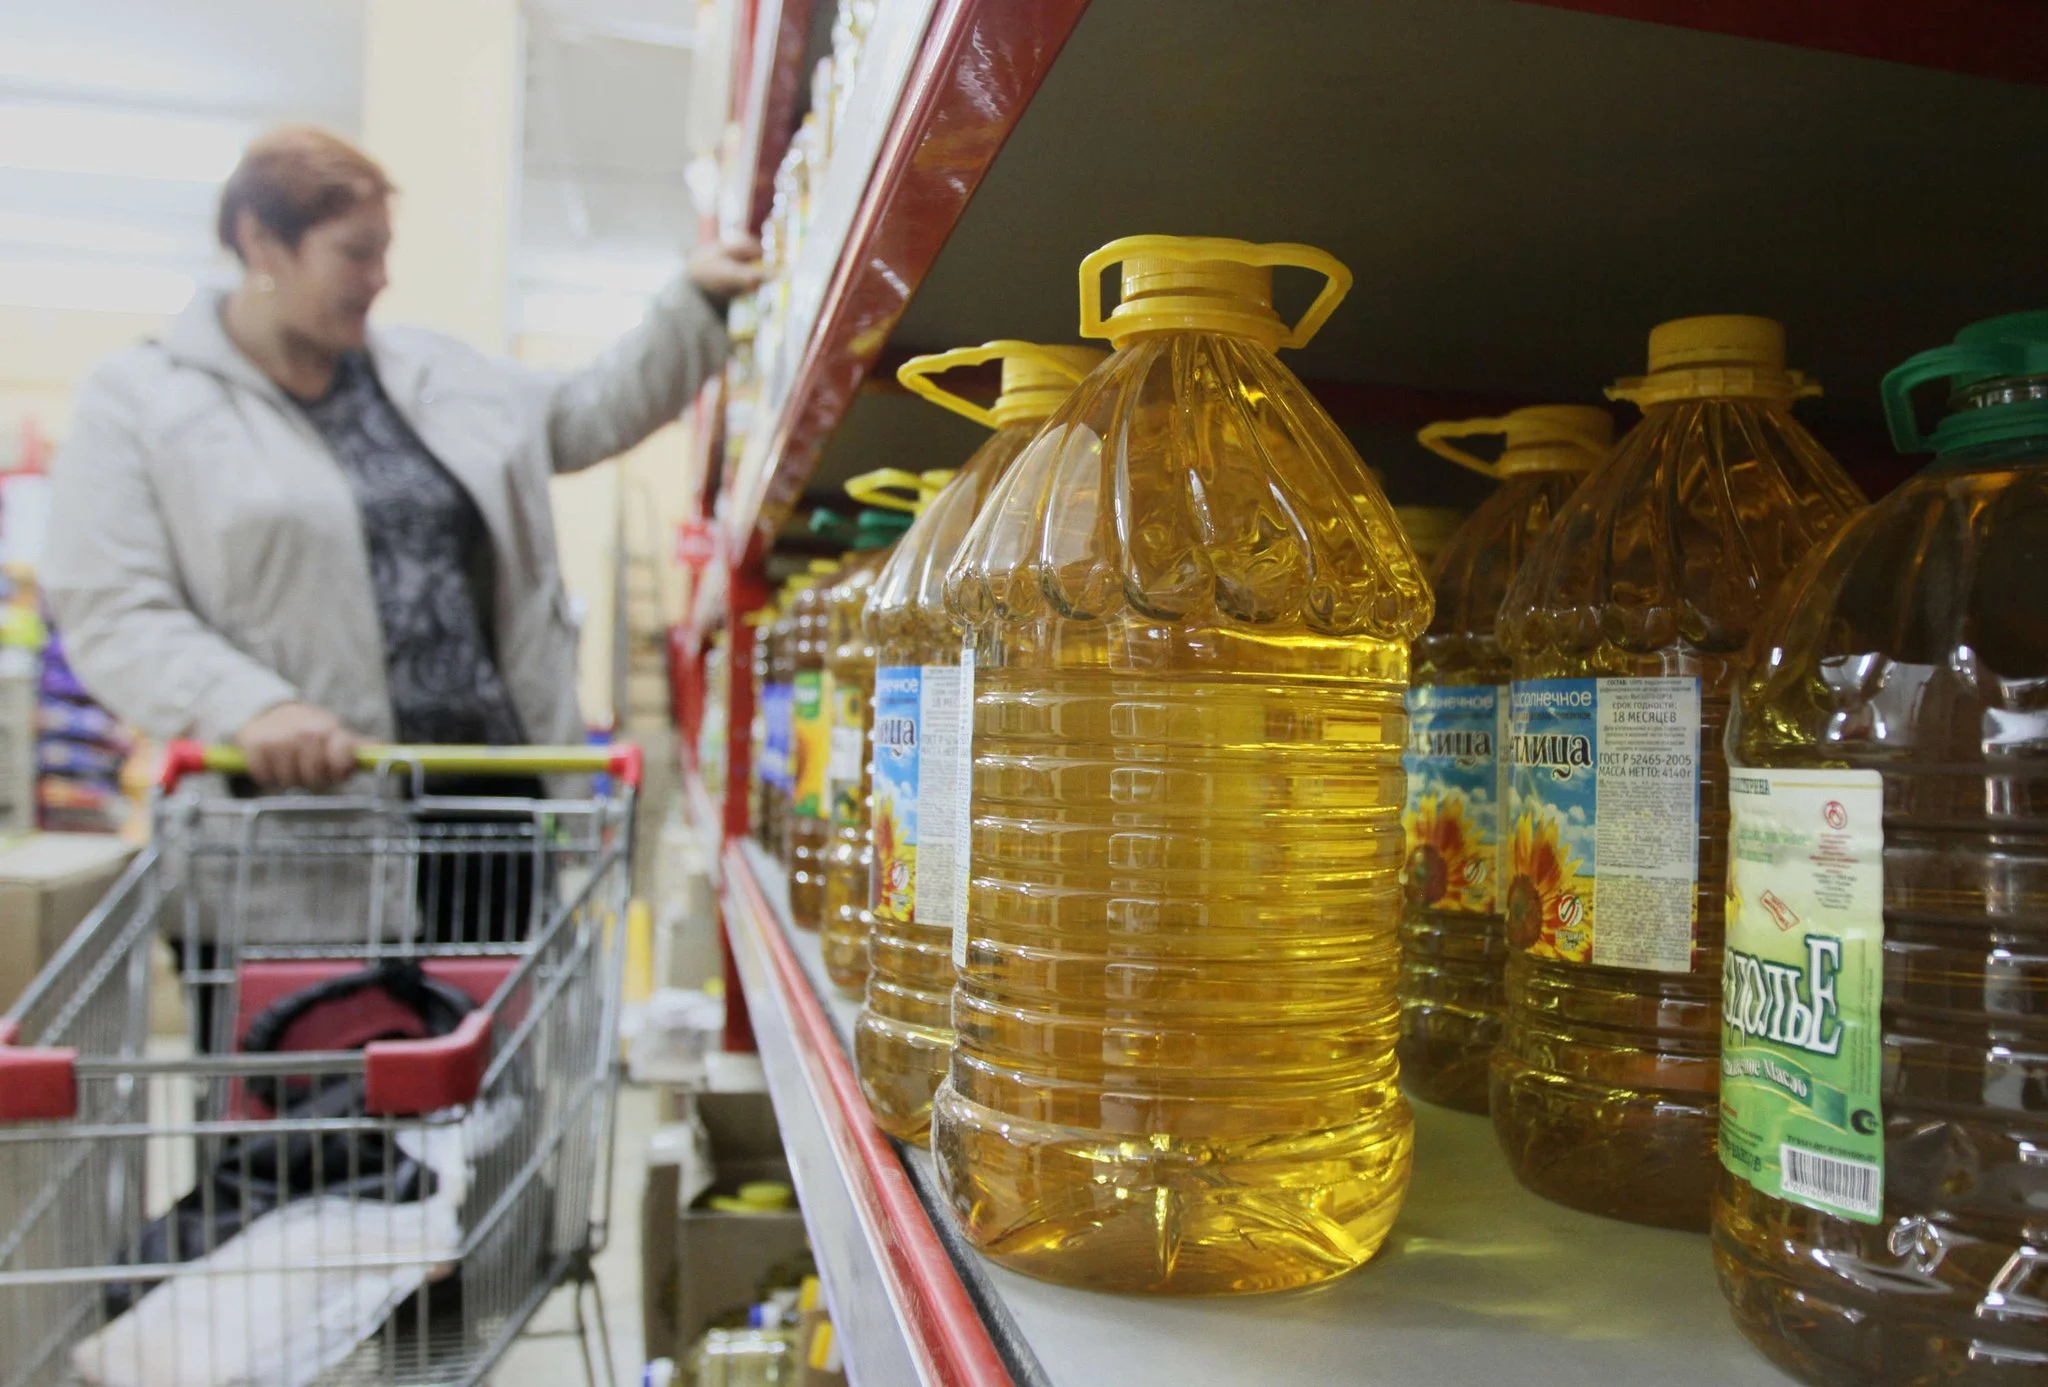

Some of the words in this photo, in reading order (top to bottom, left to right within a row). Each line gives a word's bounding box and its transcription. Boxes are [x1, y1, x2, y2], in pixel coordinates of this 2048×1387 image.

[1613, 712, 1625, 723] 18
[1628, 712, 1677, 724] МЕСЯЦЕВ
[1599, 753, 1620, 765] ГОСТ
[1623, 753, 1629, 764] Р
[1631, 754, 1692, 766] 52465-2005
[1598, 766, 1625, 777] МАССА
[1629, 767, 1661, 778] НЕТТО:
[1763, 1057, 1808, 1098] Масло
